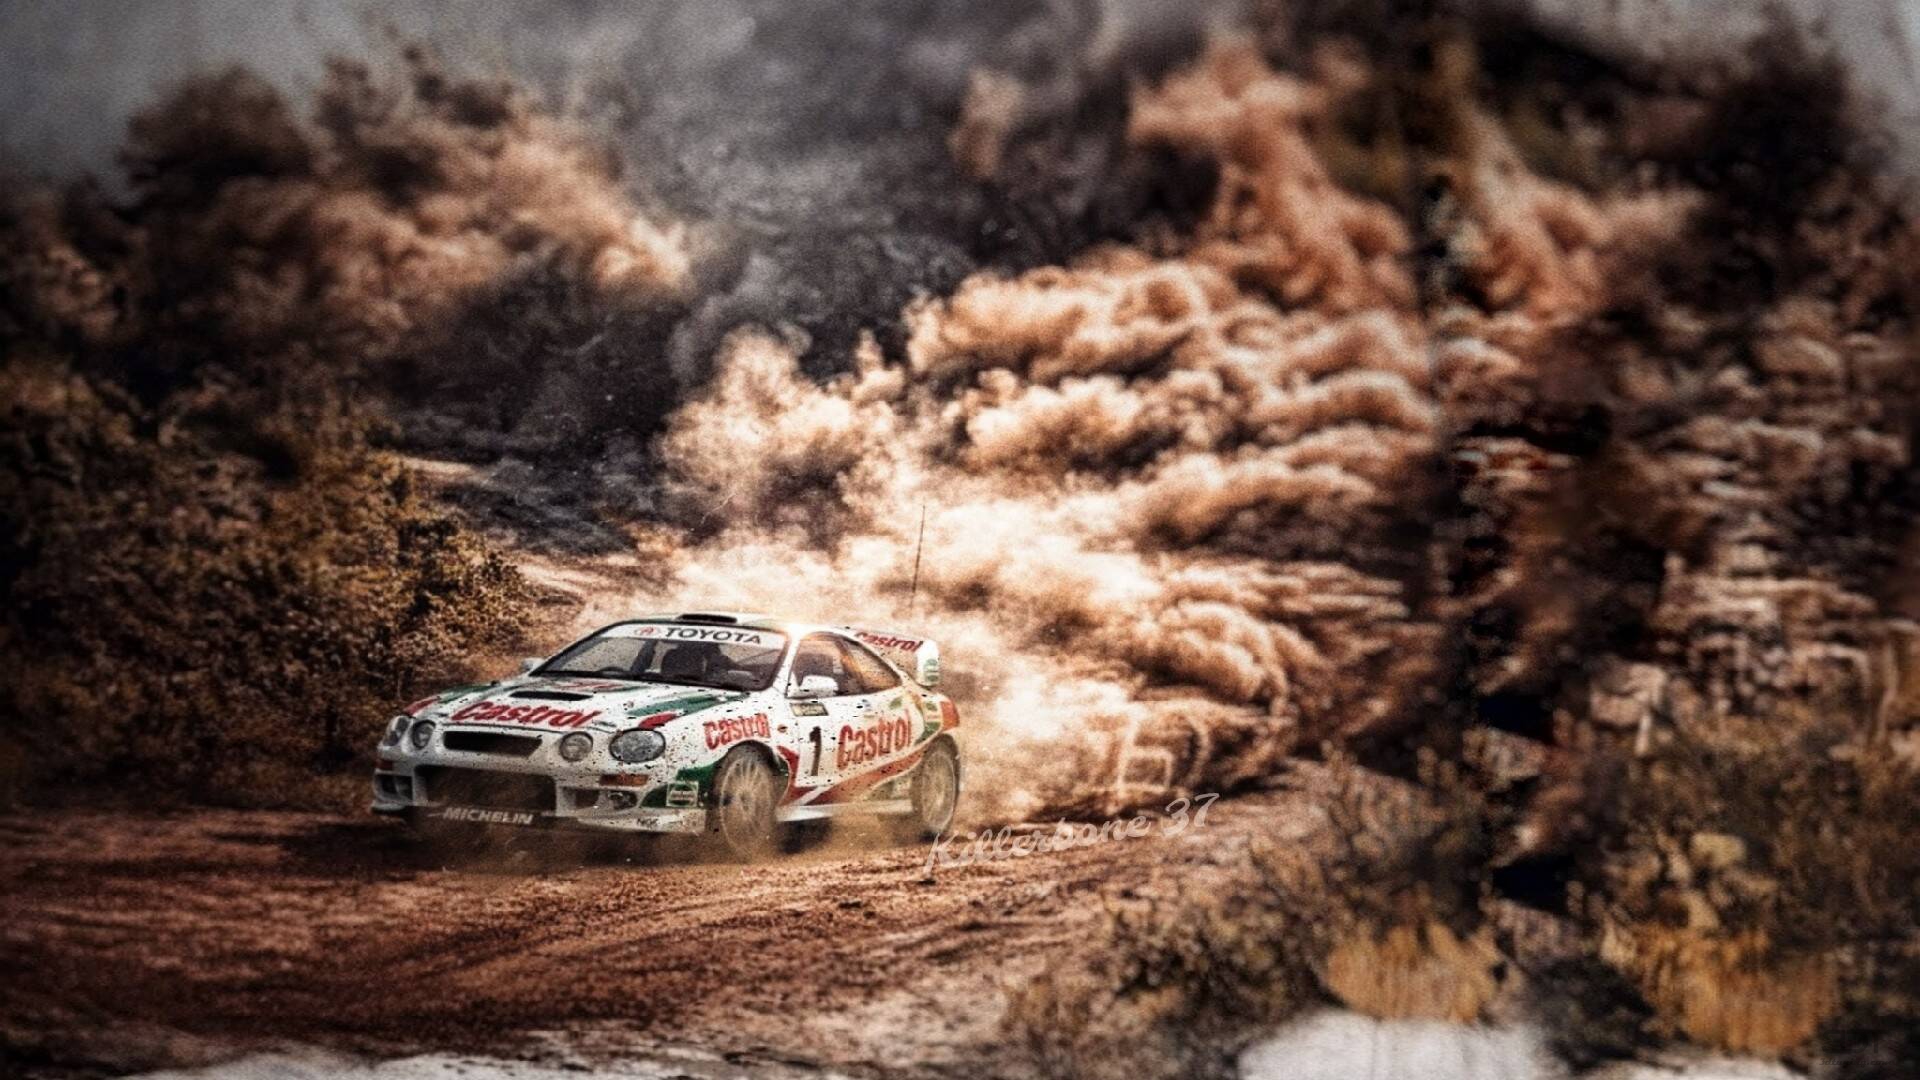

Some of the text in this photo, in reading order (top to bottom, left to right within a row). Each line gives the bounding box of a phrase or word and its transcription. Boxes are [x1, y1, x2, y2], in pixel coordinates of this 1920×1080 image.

[665, 627, 761, 644] TOYOTA
[452, 702, 602, 728] Castrol
[809, 726, 823, 776] 1
[836, 710, 911, 770] Castrol
[442, 807, 533, 824] MICHELIN
